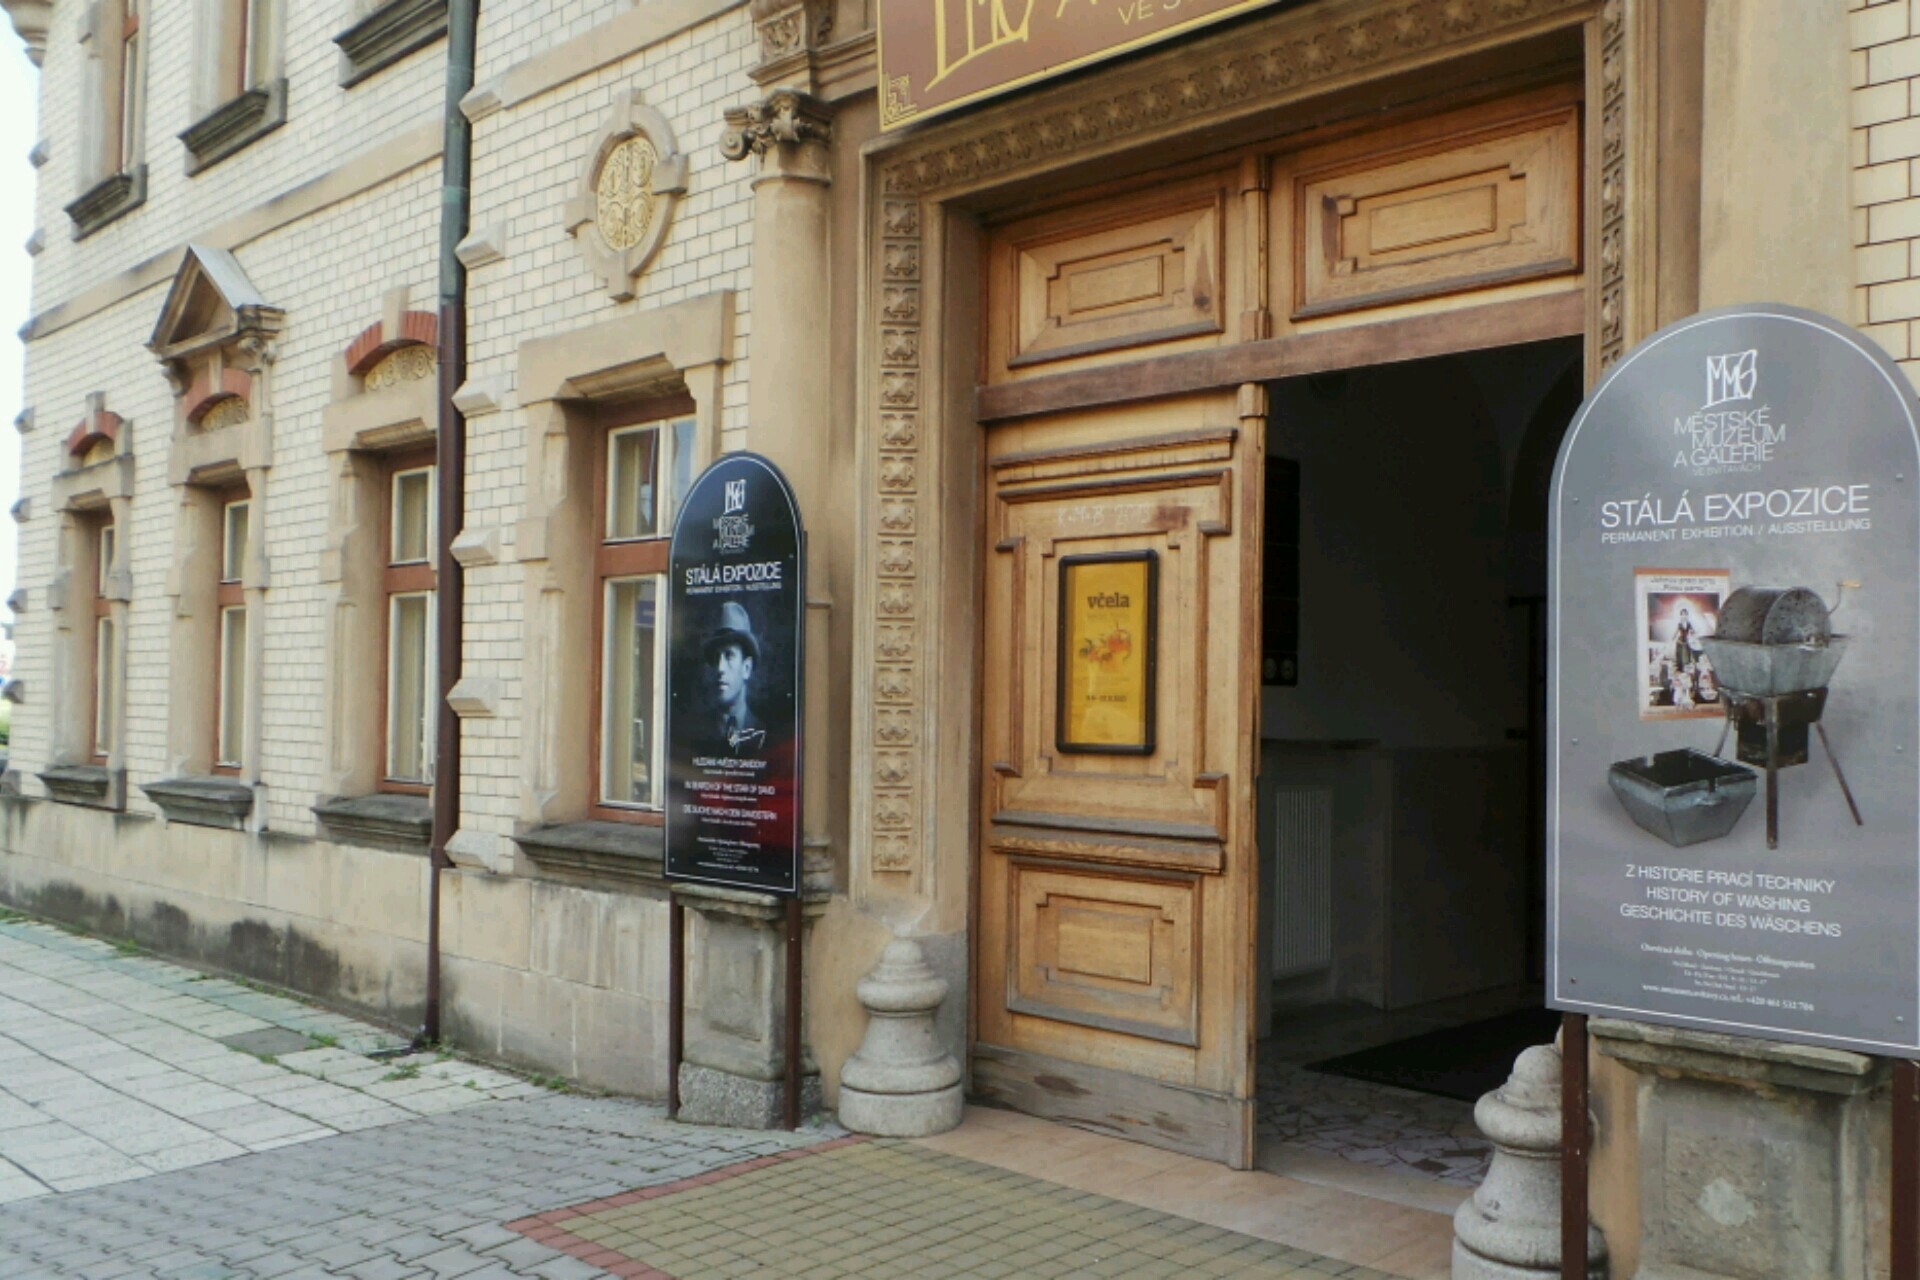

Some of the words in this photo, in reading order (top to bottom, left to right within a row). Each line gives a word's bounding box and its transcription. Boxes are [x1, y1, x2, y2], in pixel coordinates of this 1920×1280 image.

[1673, 449, 1688, 468] A
[1690, 442, 1775, 467] GALERIE
[1601, 489, 1695, 528] STÁLÁ
[1704, 484, 1871, 522] EXPOZICE
[1601, 528, 1677, 544] PERMANENT
[1681, 524, 1753, 541] EXHIBITION
[1768, 518, 1872, 536] AUSSTELLUNG
[686, 563, 722, 586] STÁLÁ
[723, 561, 782, 584] EXPOZICE
[1087, 592, 1131, 609] včela
[1625, 864, 1636, 878] Z
[1638, 866, 1704, 884] HISTORIE
[1706, 870, 1753, 888] PRACÍ
[1755, 873, 1836, 894] TECHNIKY
[1646, 885, 1710, 904] HISTORY
[1712, 892, 1734, 906] OF
[1736, 894, 1811, 913] WASHING
[1620, 902, 1712, 925] GESCHICHTE
[1716, 912, 1747, 929] DES
[1749, 913, 1842, 937] WÄSCHENS
